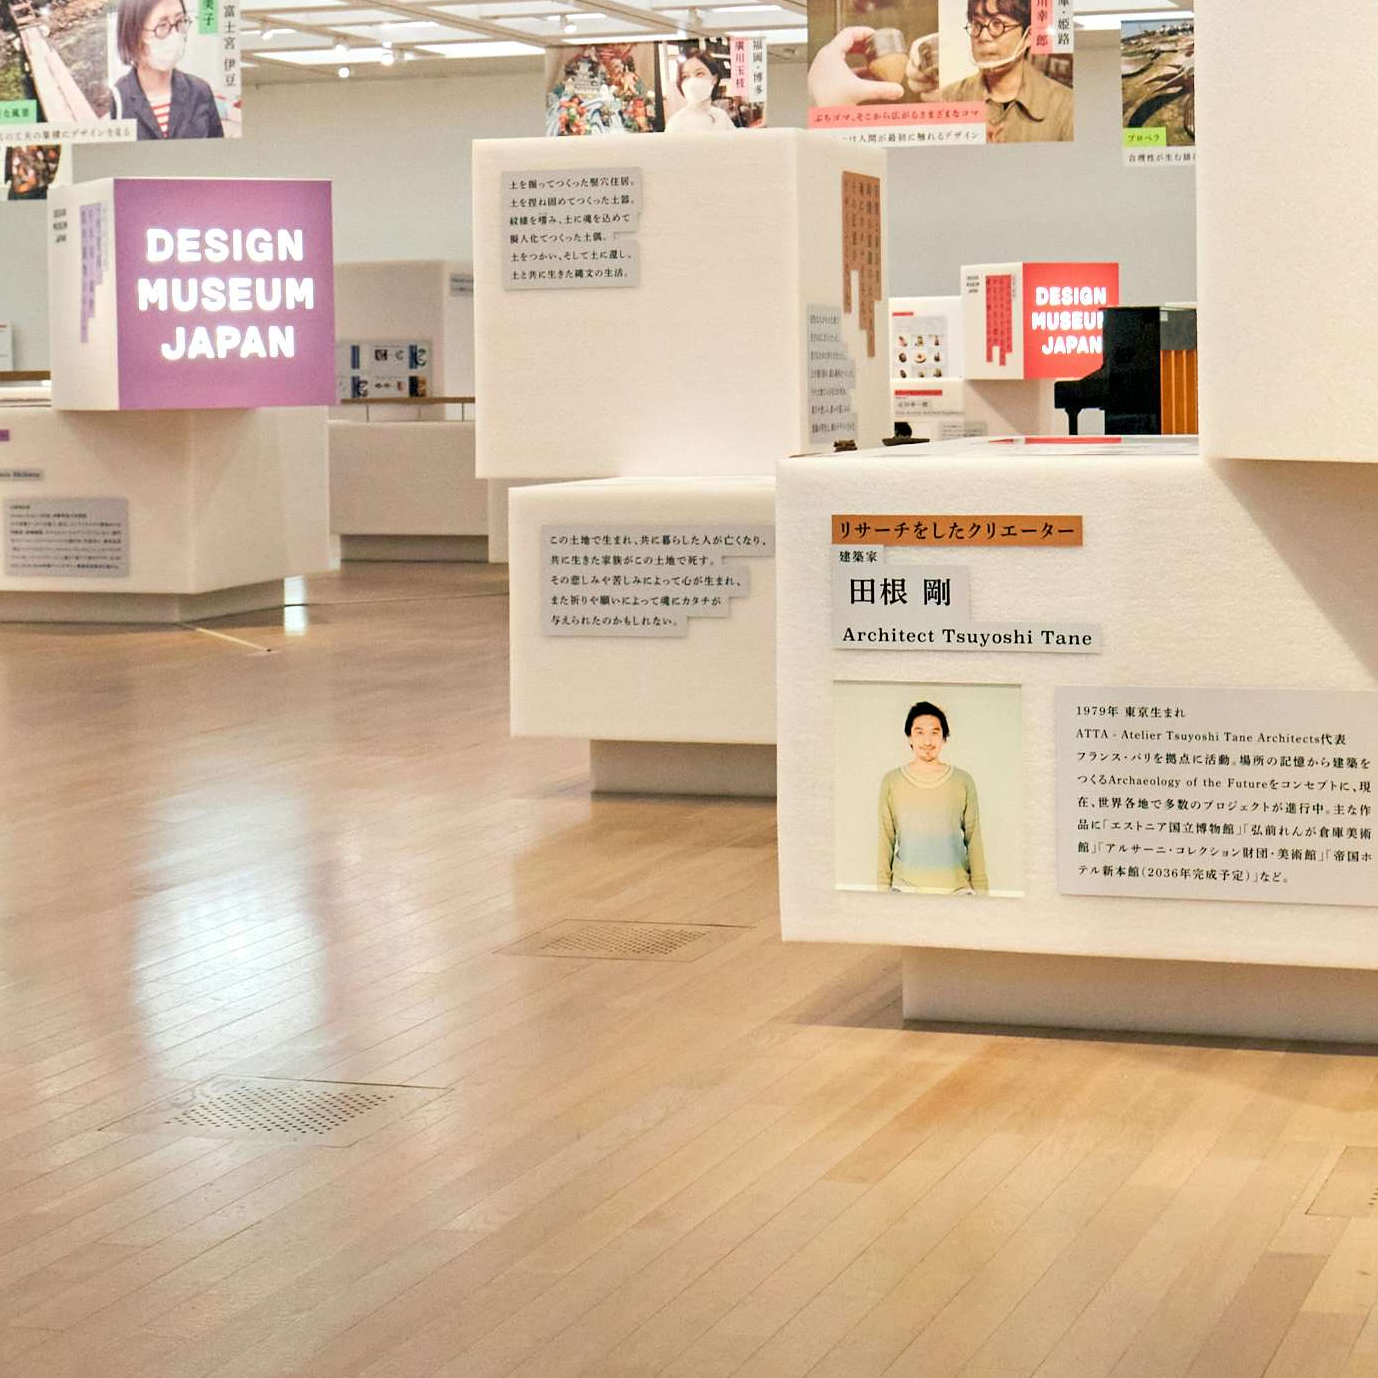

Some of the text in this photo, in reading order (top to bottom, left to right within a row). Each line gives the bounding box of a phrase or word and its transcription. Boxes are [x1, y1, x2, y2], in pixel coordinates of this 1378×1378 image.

[146, 227, 304, 263] DESIGN
[137, 277, 315, 312] MUSEUM
[1035, 286, 1107, 306] DESIGN
[161, 325, 295, 361] JAPAN
[1041, 335, 1103, 355] JAPAN
[840, 521, 1075, 540] リサーチをしたクリエーター
[839, 550, 878, 563] 建築家
[850, 577, 951, 606] 田根 剛
[843, 627, 1092, 648] Architect Tsuyoshi Tane
[1075, 705, 1186, 719] 1979年 東京生まれ
[1075, 728, 1109, 740] ATTA
[1121, 729, 1162, 741] Atelier
[1165, 730, 1220, 744] Tsuyoshi
[1223, 731, 1253, 742] Tane
[1186, 777, 1198, 787] of
[1203, 777, 1222, 788] the
